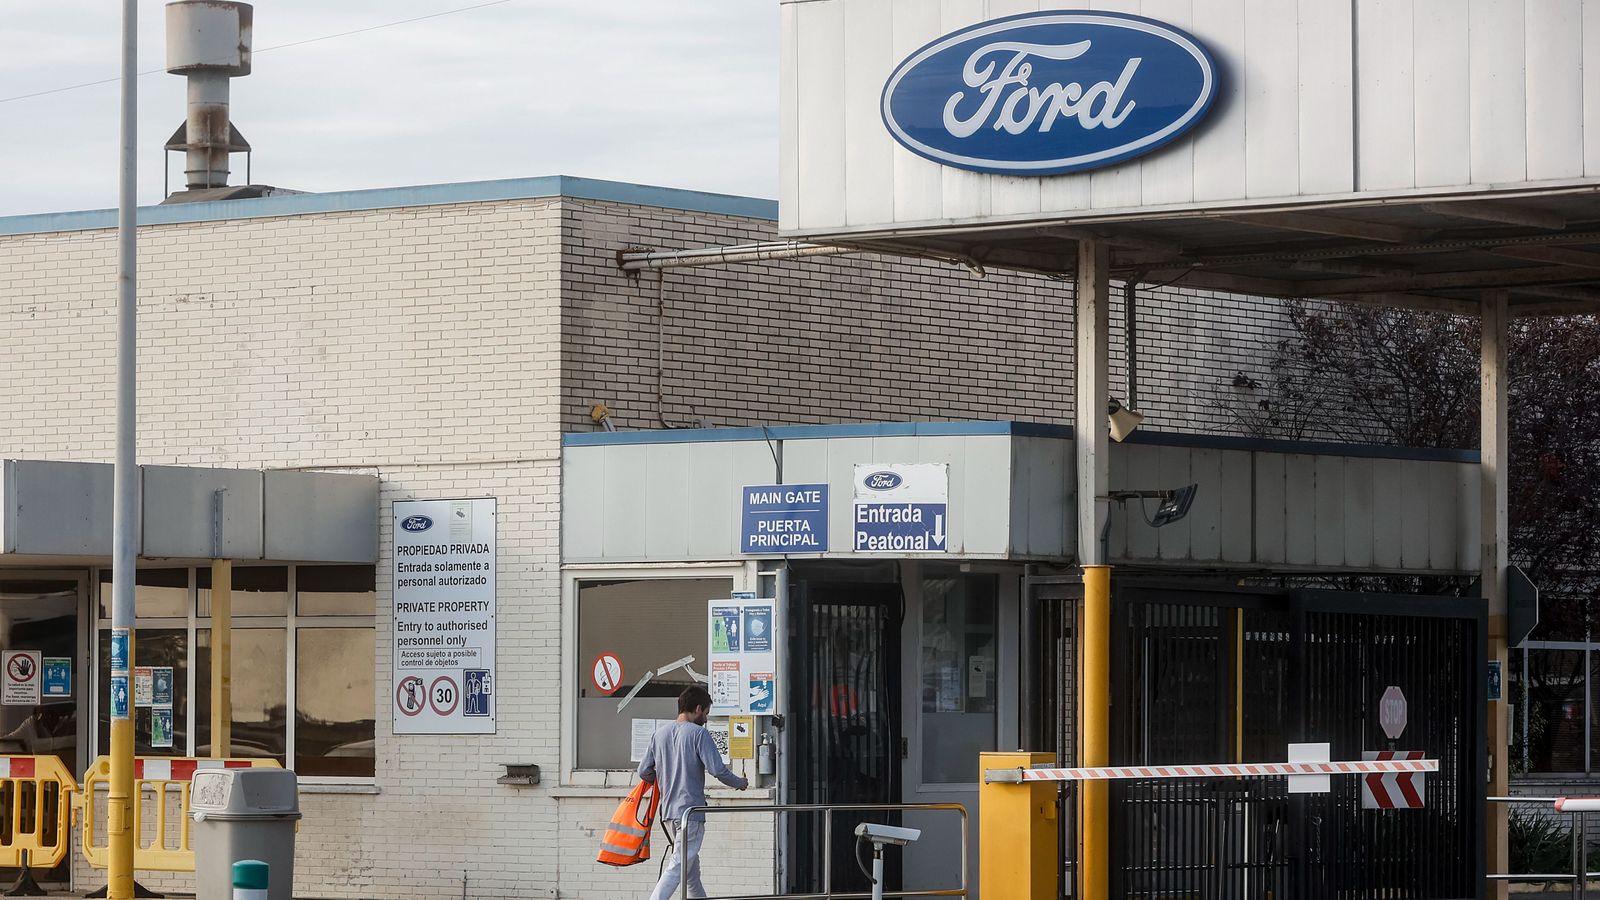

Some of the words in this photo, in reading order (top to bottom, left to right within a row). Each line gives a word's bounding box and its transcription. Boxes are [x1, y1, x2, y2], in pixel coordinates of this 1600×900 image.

[943, 39, 1142, 138] Ford
[870, 474, 894, 487] Ford
[750, 492, 781, 504] MAIN
[785, 491, 820, 504] GATE
[857, 504, 922, 523] Entrada
[406, 517, 427, 529] Ford
[758, 520, 811, 532] PUERTA
[750, 533, 819, 546] PRINCIPAL
[857, 531, 929, 550] Peatonal
[397, 545, 447, 556] PROPIEDAD
[450, 544, 490, 554] PRIVADA
[397, 562, 432, 572] Entrada
[434, 561, 481, 571] solamente
[484, 562, 489, 570] a
[397, 576, 436, 589] personal
[438, 575, 486, 585] autorizado
[397, 602, 435, 612] PRIVATE
[438, 601, 489, 611] PROPERTY
[397, 621, 422, 633] Entry
[425, 621, 434, 631] to
[436, 620, 488, 631] authorised
[397, 635, 443, 648] personnel
[446, 634, 467, 647] only
[426, 651, 446, 659] sujeto
[453, 650, 477, 658] posible
[434, 659, 459, 667] objetos
[436, 688, 452, 703] 30
[1384, 699, 1404, 724] STOP
